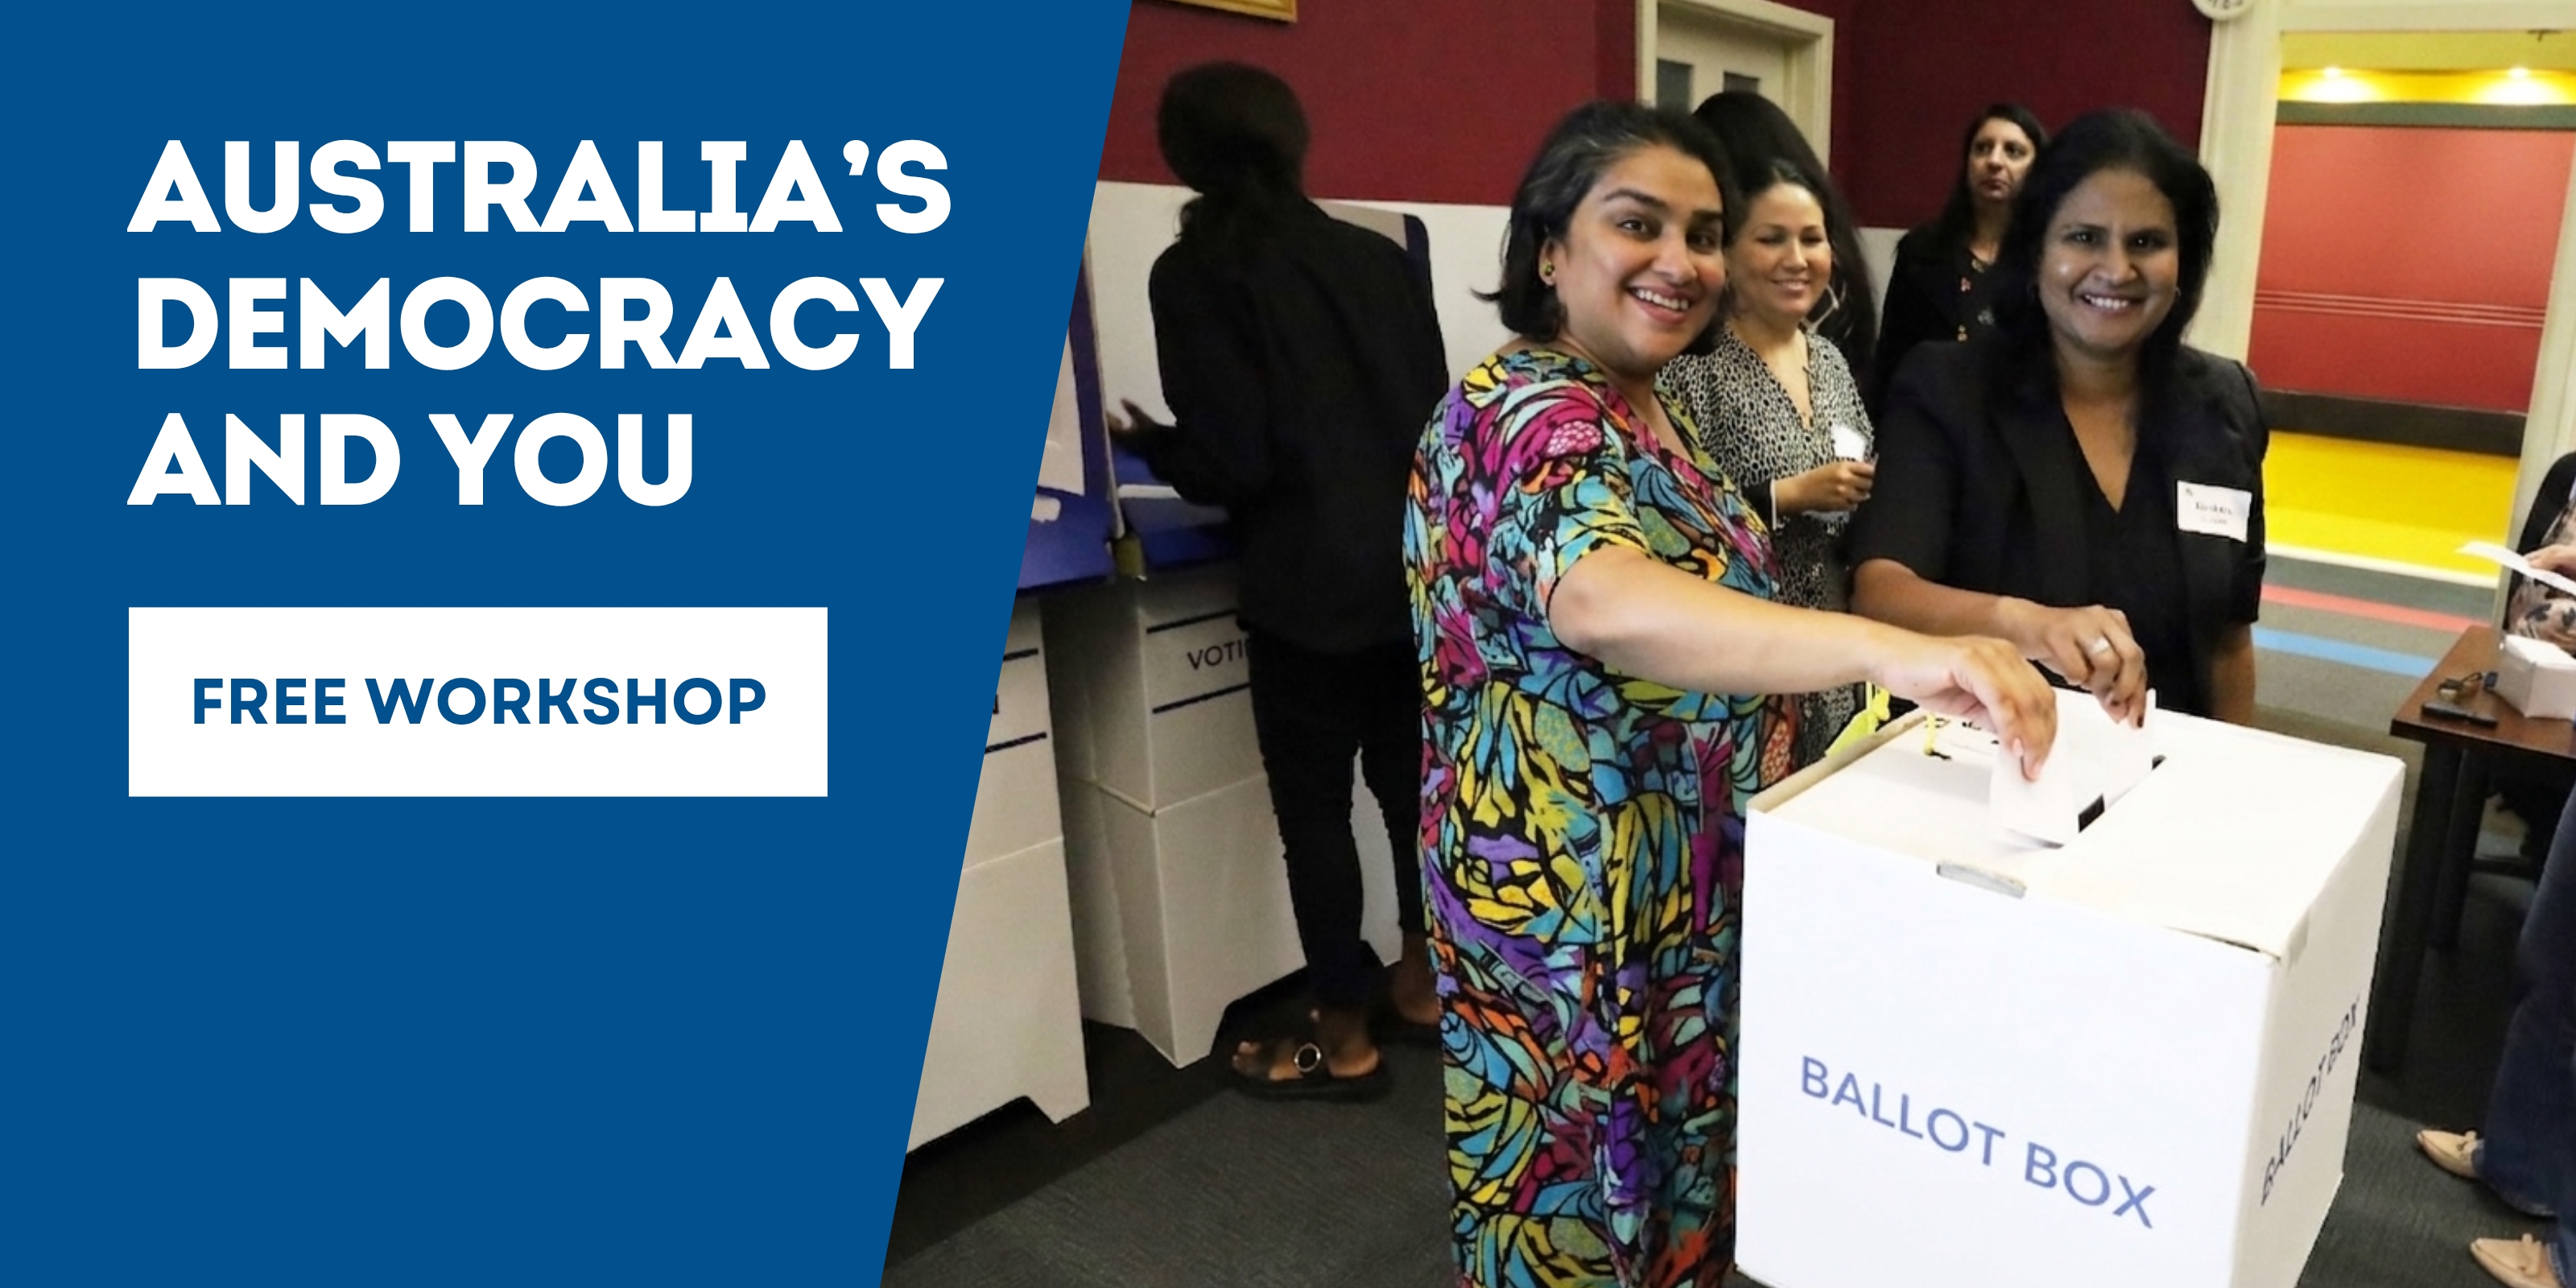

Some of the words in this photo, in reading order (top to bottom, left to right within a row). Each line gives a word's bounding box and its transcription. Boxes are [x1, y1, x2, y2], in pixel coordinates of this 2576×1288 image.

[1802, 1056, 2006, 1166] BALLOT
[2025, 1142, 2156, 1228] BOX
[2260, 1054, 2326, 1207] BALLOT
[2326, 995, 2359, 1076] BOX
